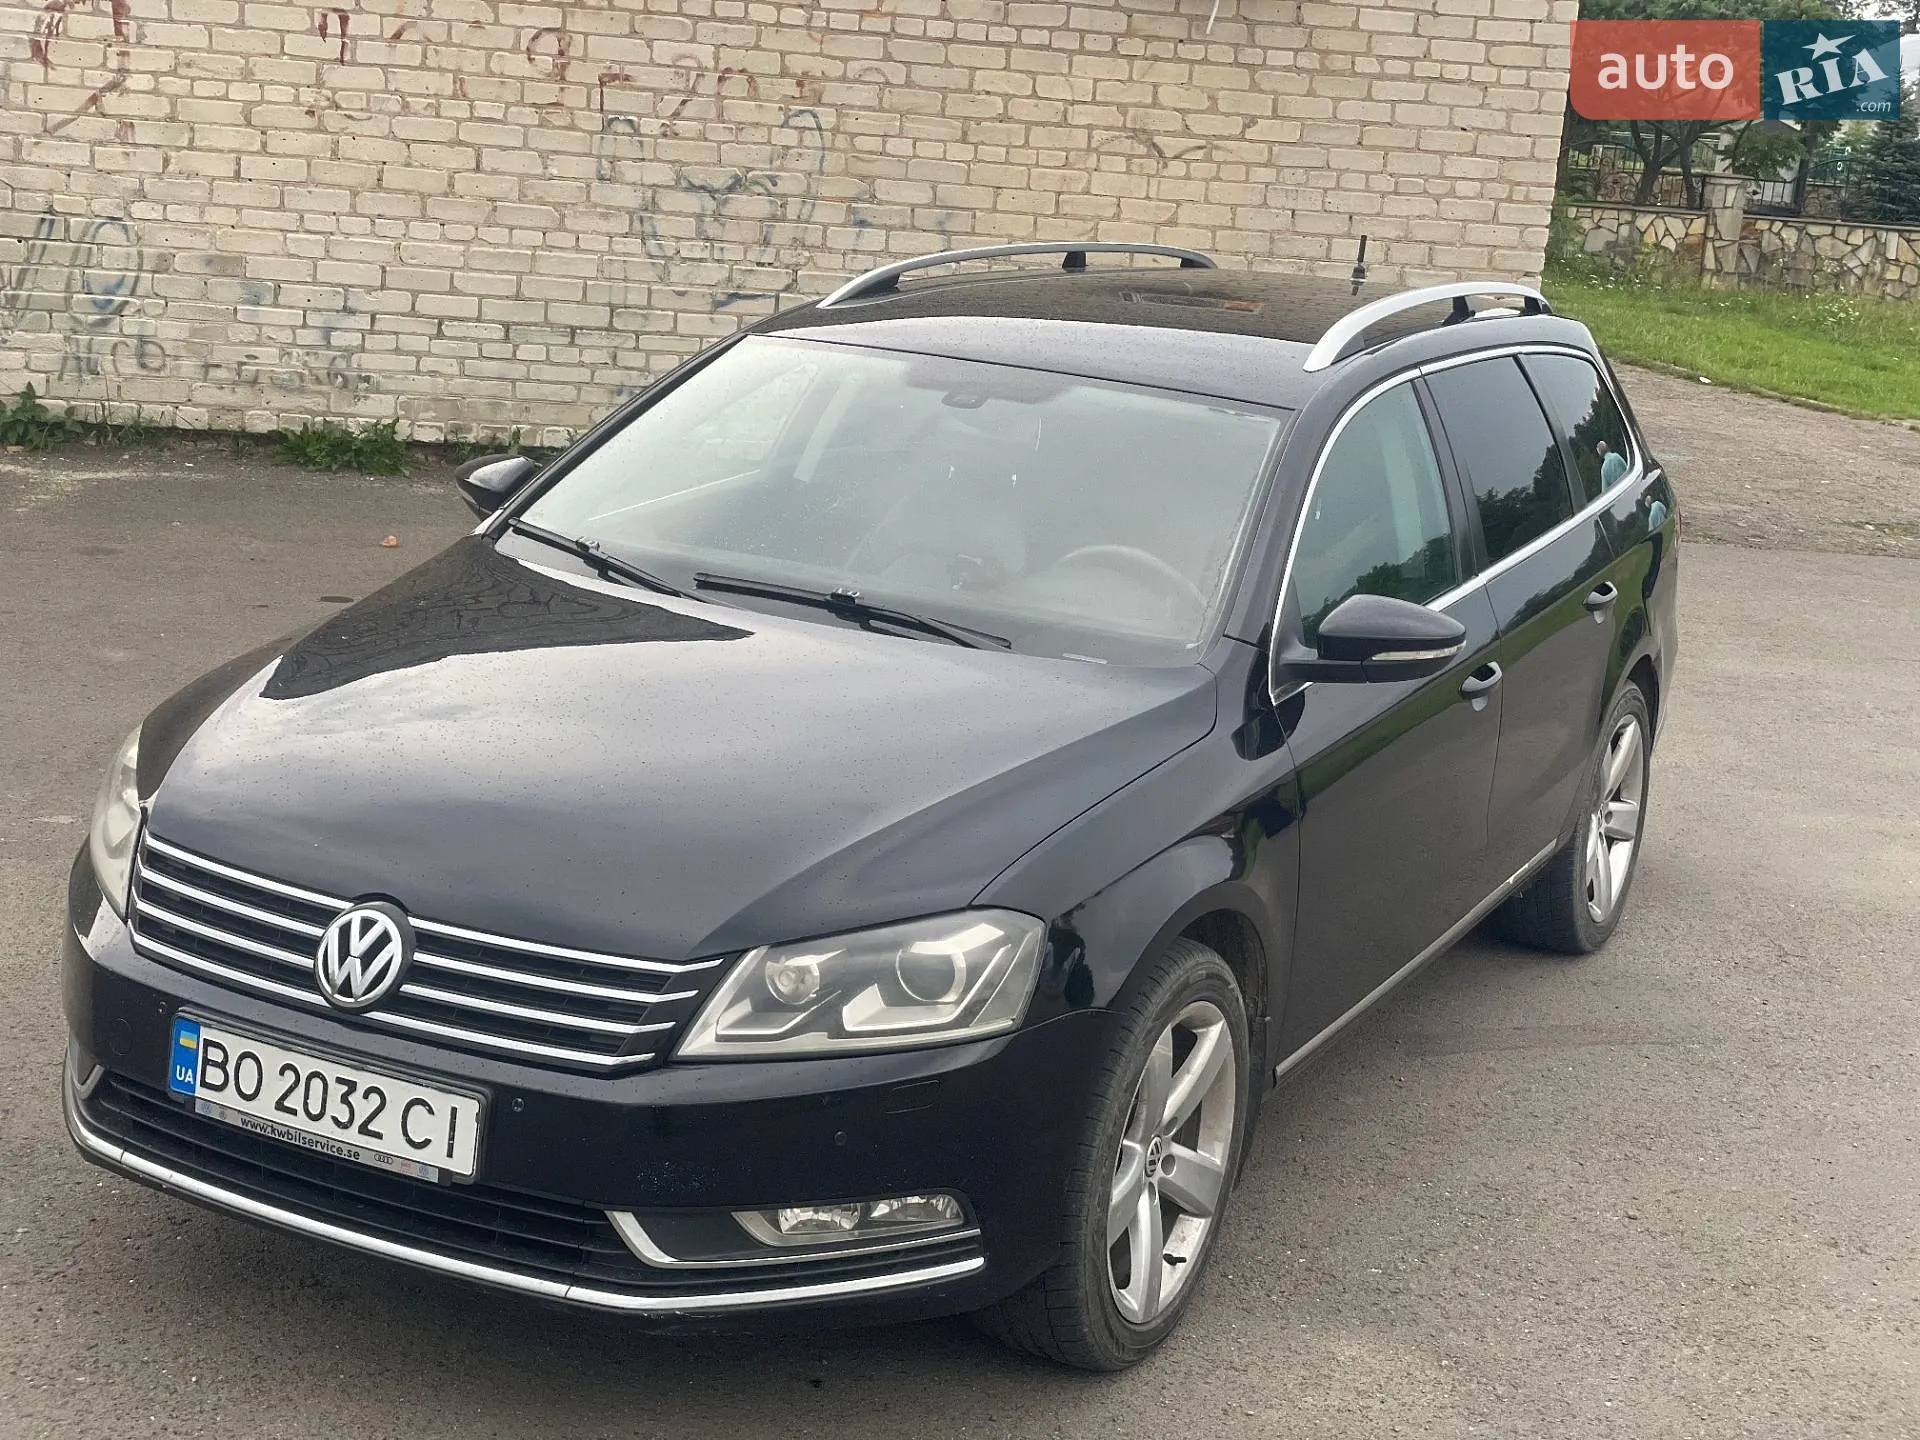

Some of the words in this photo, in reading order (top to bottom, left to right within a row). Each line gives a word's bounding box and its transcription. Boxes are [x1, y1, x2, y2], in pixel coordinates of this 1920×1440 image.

[175, 1065, 194, 1085] UA
[199, 1038, 263, 1101] BO
[274, 1062, 388, 1140] 2032
[401, 1097, 458, 1158] CI
[240, 1115, 360, 1161] www.kwbilservice.se
